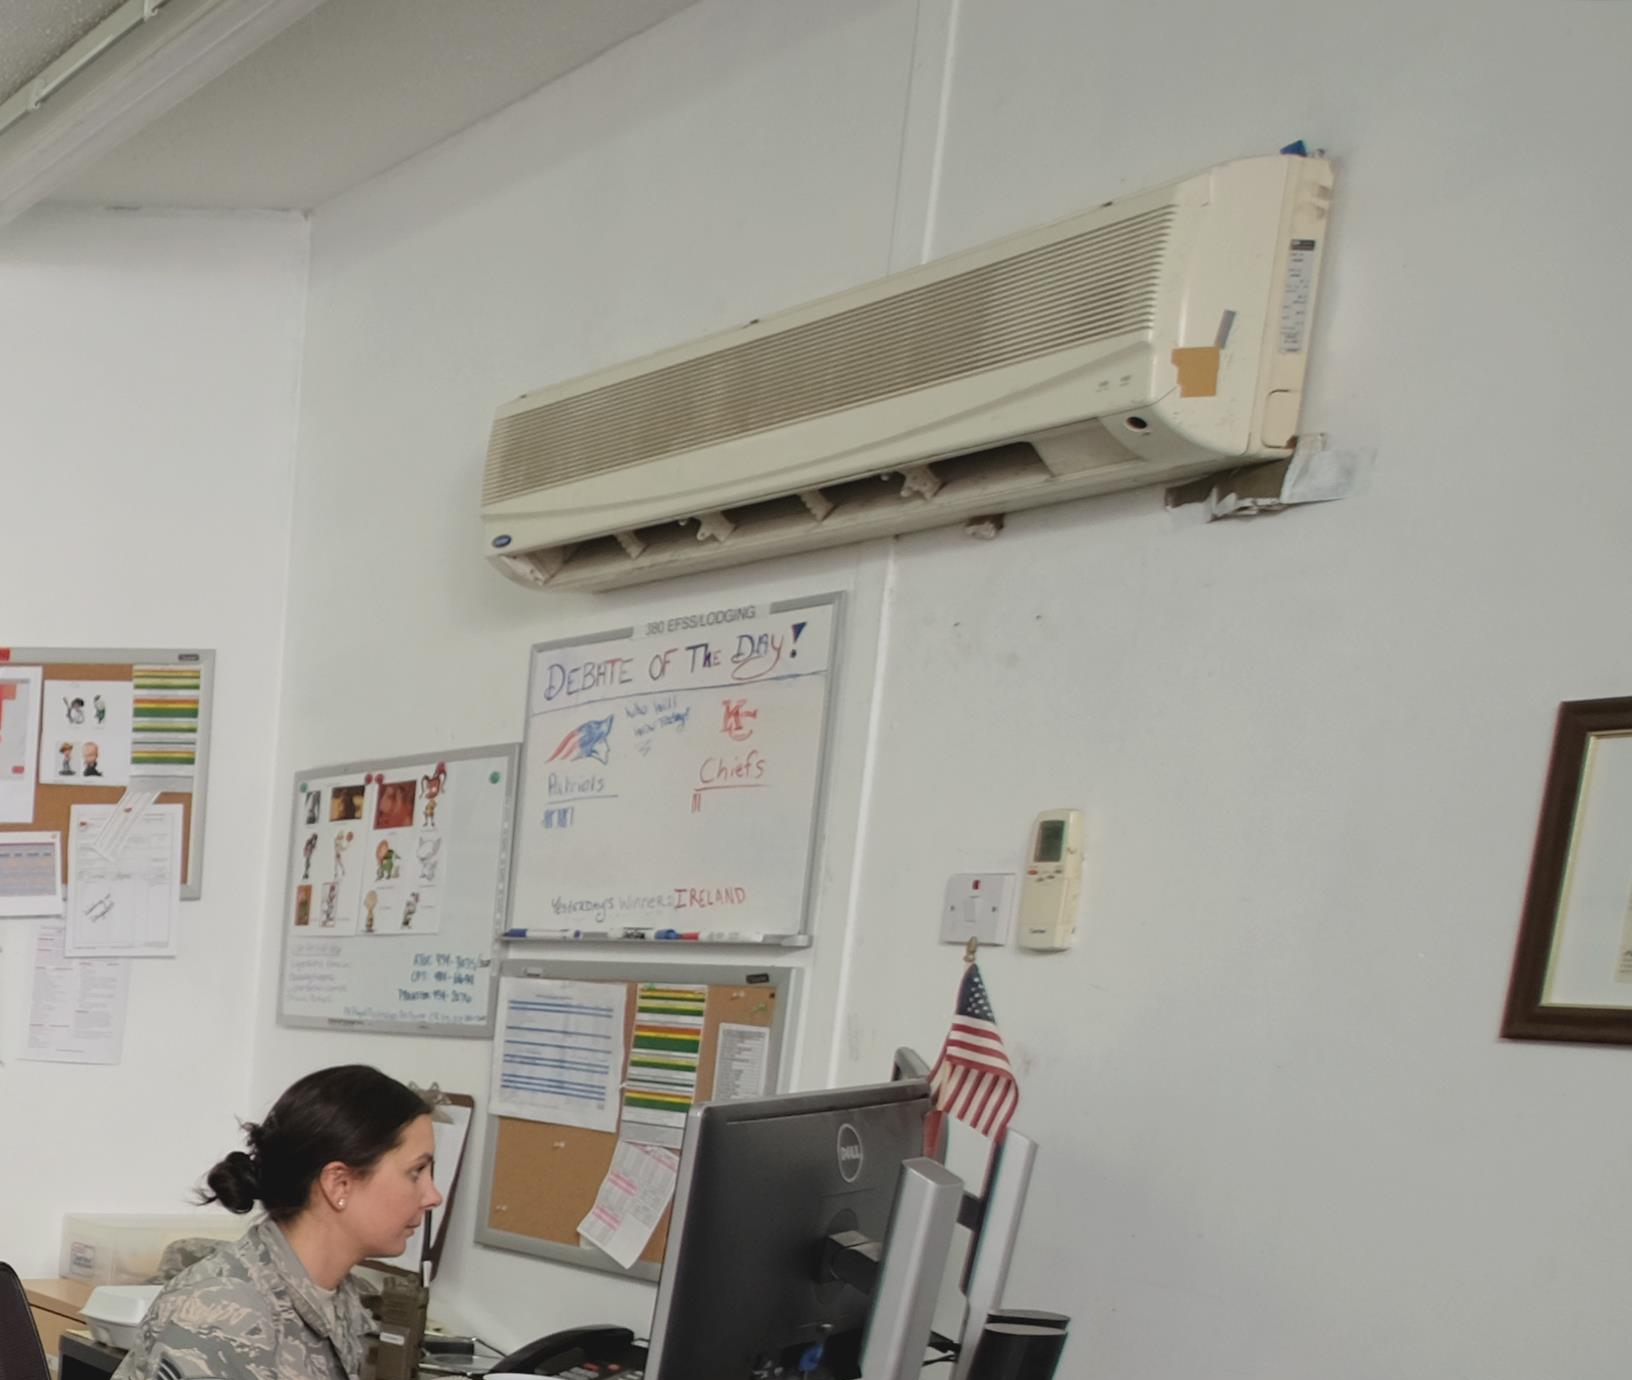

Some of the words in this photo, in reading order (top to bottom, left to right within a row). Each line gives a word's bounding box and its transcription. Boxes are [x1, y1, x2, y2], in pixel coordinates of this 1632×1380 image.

[544, 658, 634, 701] DEBATE
[649, 648, 679, 681] OF
[699, 750, 766, 784] Chiefs
[674, 887, 746, 911] IRELAND
